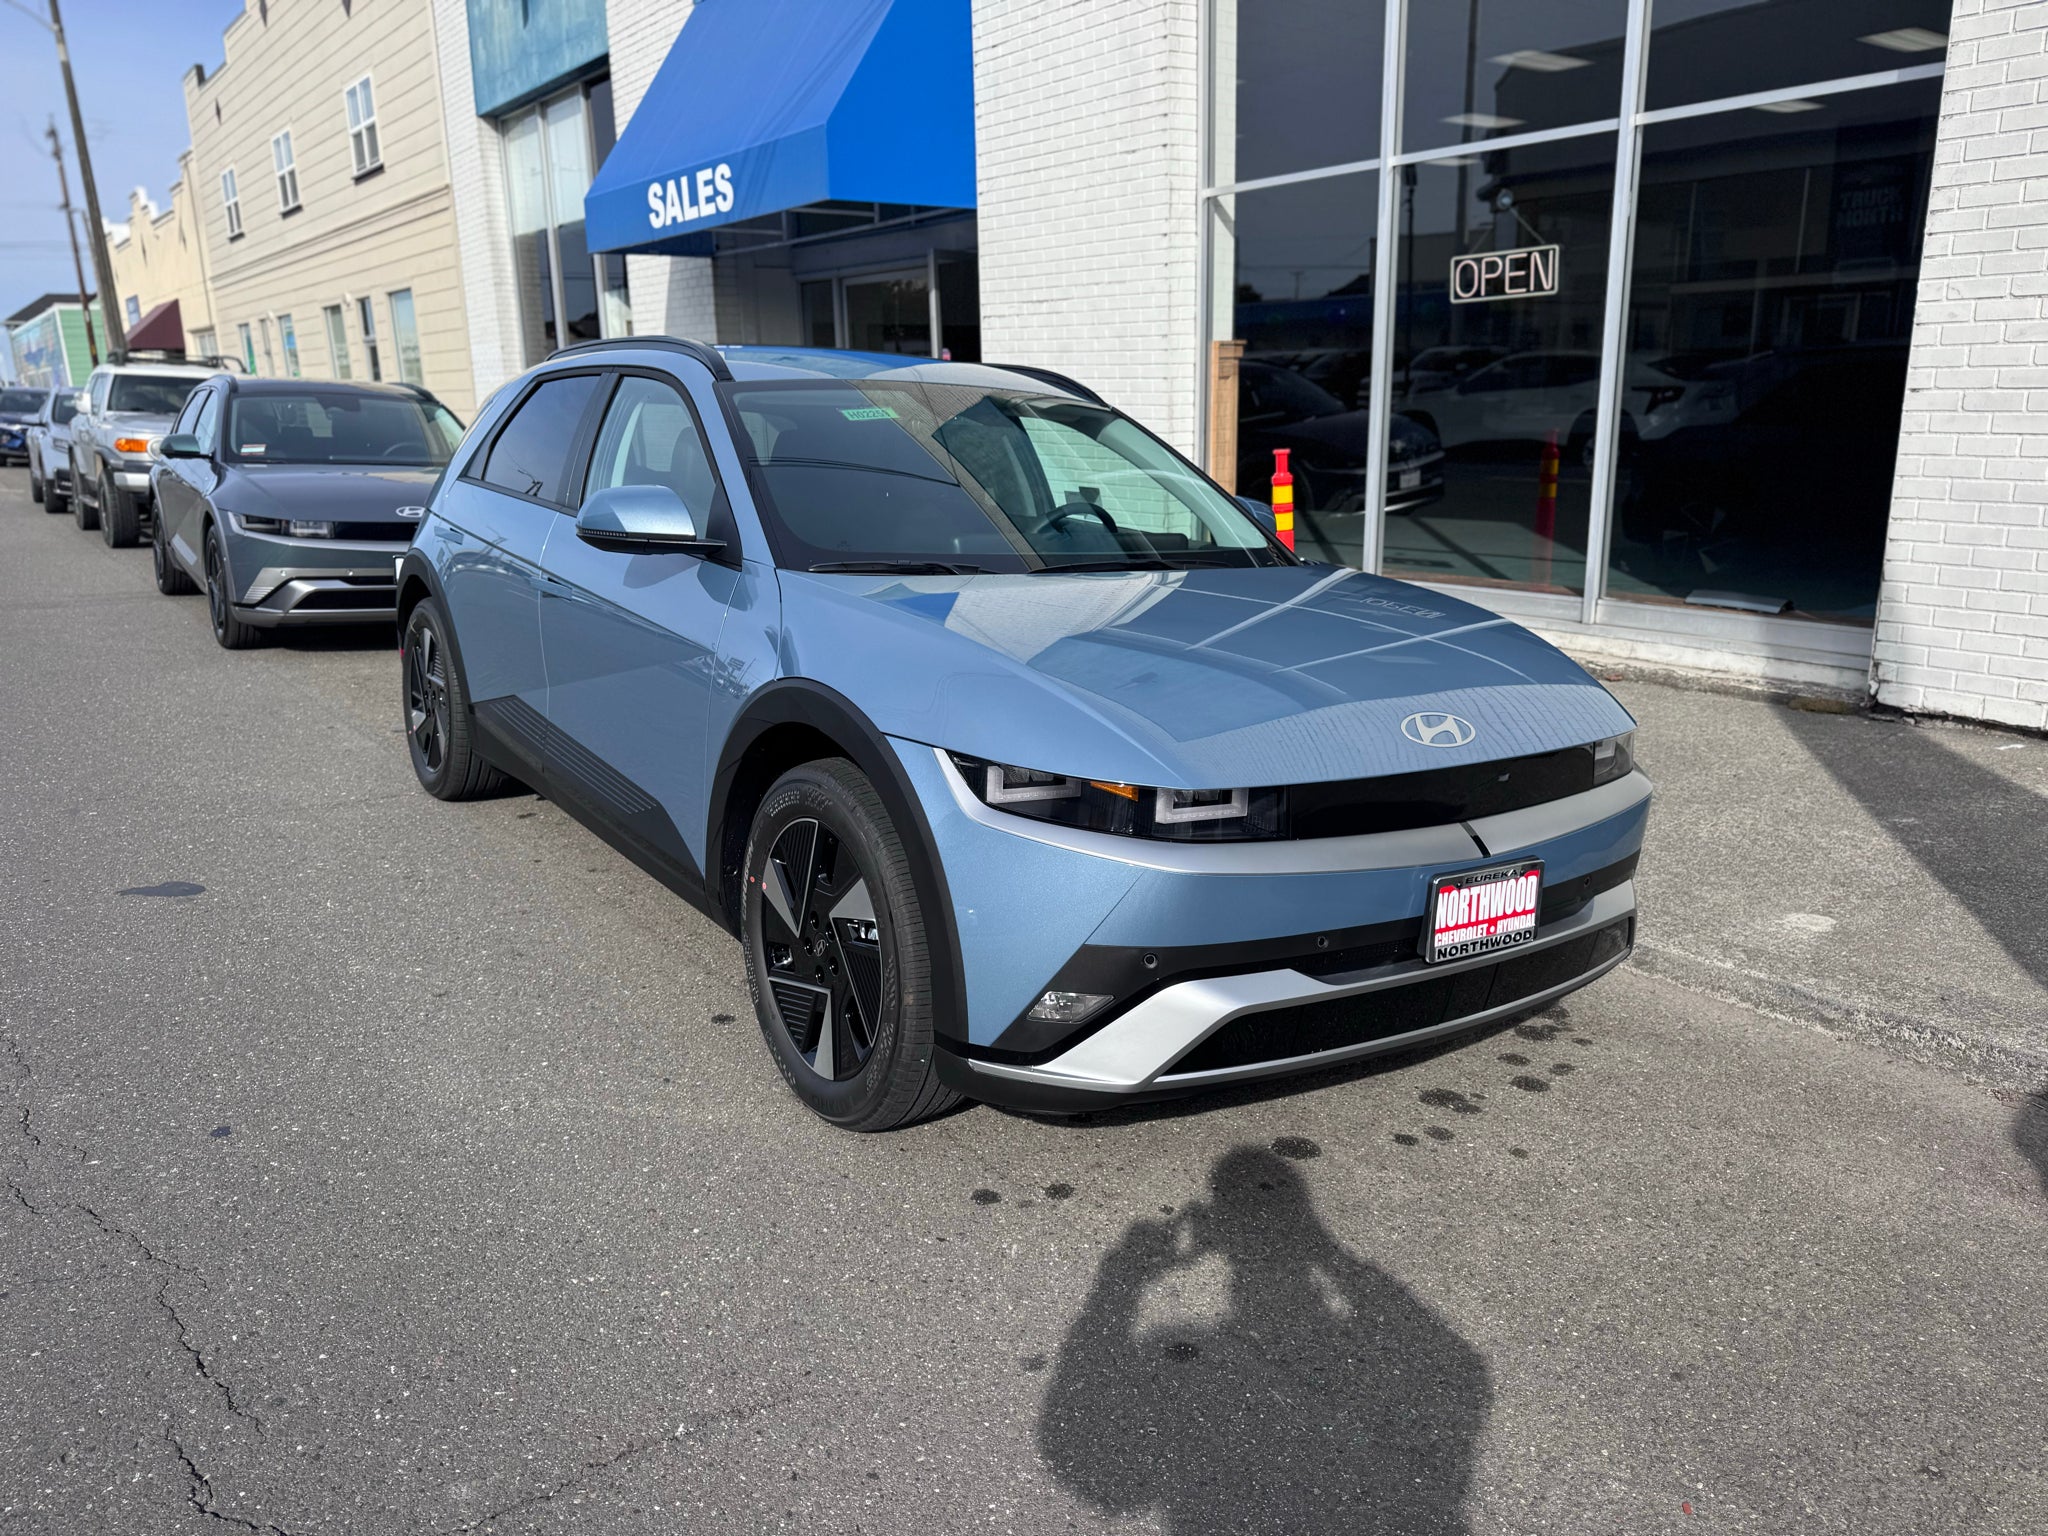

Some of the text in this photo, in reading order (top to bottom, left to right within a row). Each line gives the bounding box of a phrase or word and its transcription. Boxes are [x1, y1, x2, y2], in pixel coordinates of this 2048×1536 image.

[647, 163, 734, 229] SALES
[1456, 250, 1554, 298] OPEN
[1465, 869, 1518, 884] EUREKA
[1435, 875, 1538, 930] NORTHWOOD
[1434, 913, 1536, 948] CHEVROLET HYUNDAI
[1437, 930, 1532, 960] NORTHWOOD
